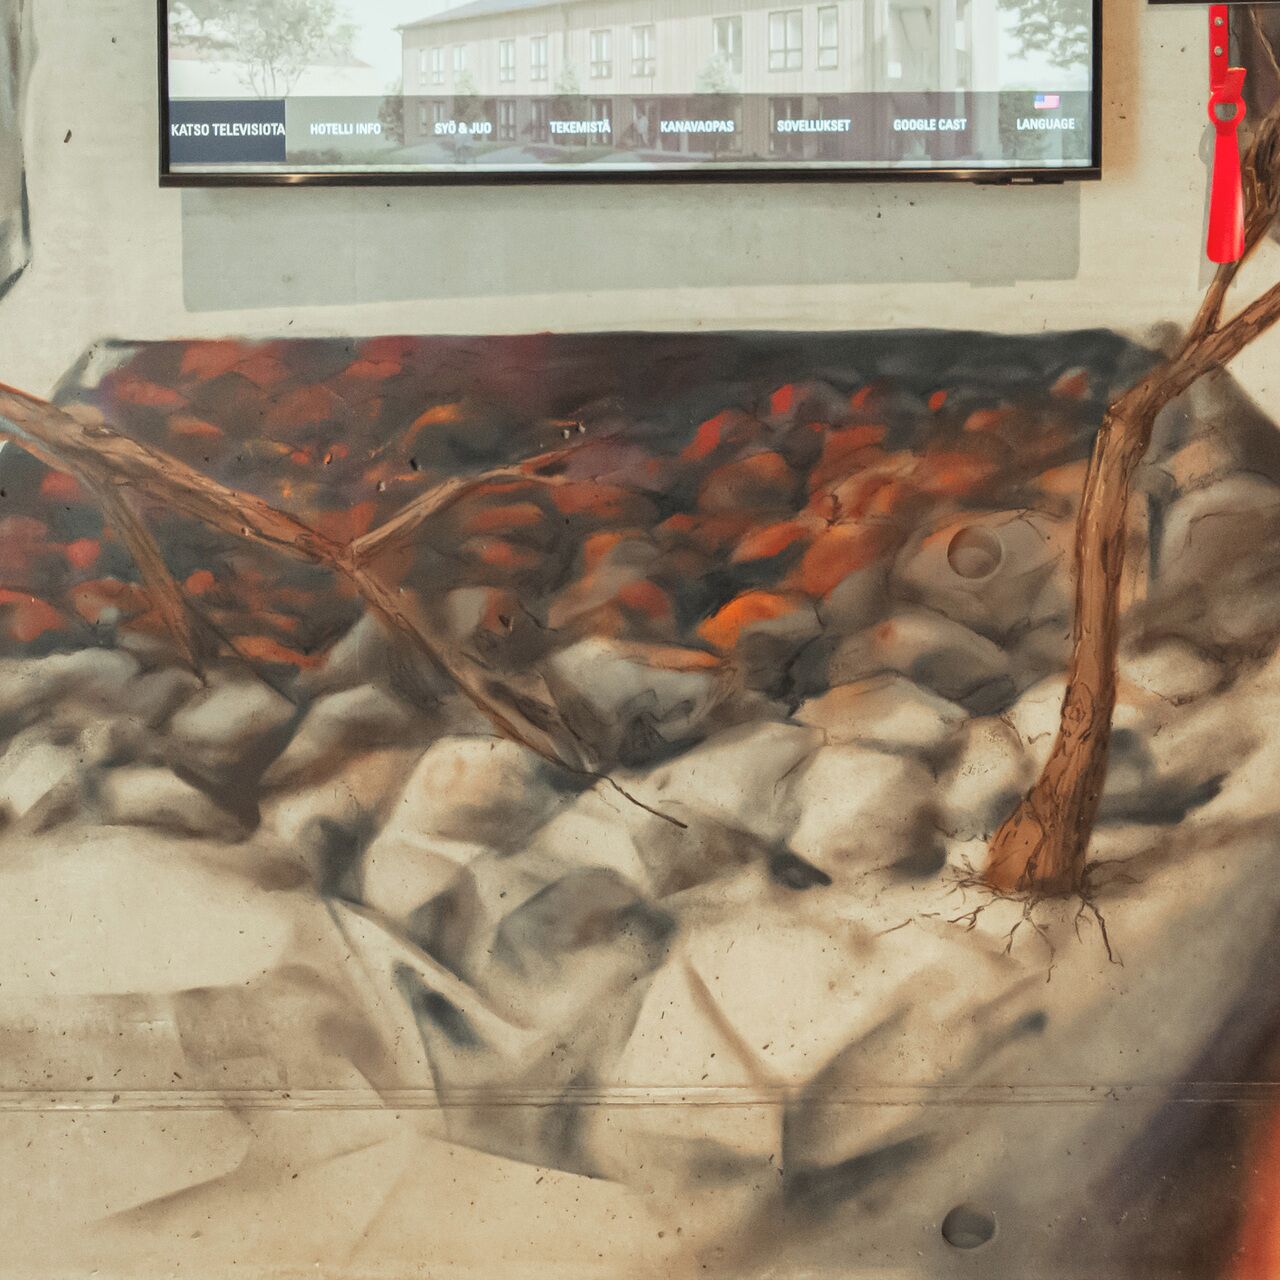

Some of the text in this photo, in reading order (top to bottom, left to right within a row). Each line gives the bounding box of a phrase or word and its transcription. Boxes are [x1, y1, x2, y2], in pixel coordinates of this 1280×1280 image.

[170, 122, 286, 137] KATSO TELEVISIOTA
[309, 122, 381, 135] HOTELLI INFO
[434, 120, 492, 134] SYÖ & JUO
[549, 118, 611, 134] TEKEMISTÄ
[660, 119, 734, 133] KANAVAOPAS
[776, 118, 851, 132] SOVELLUKSET
[893, 118, 967, 131] GOOGLE CAST
[1016, 117, 1075, 130] LANGUAGE
